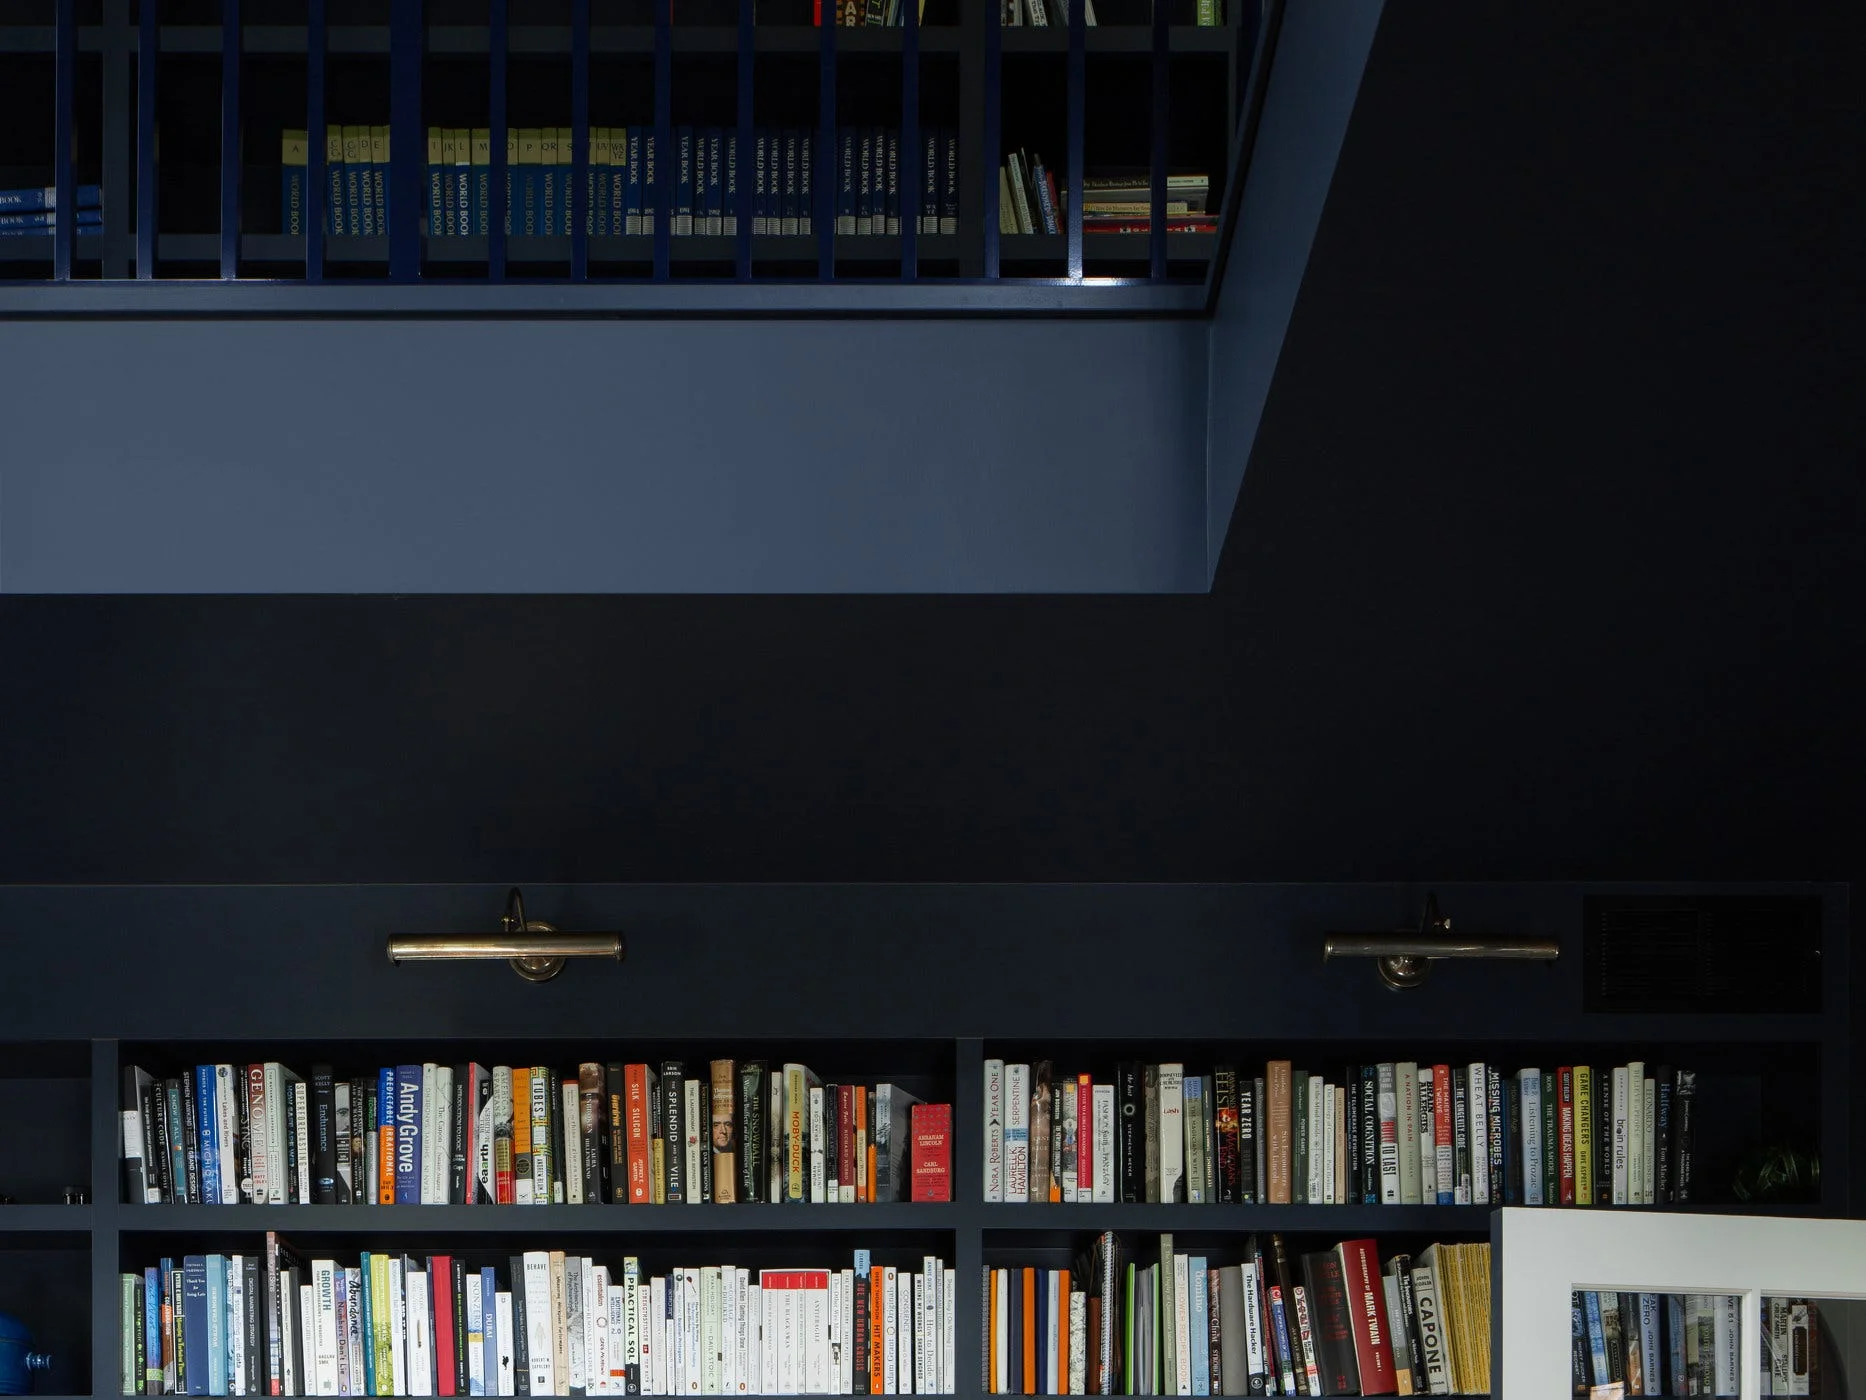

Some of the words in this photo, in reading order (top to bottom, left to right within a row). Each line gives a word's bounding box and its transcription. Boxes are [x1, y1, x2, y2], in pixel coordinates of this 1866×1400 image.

[630, 137, 638, 159] YEAR
[681, 136, 689, 157] YEAR
[332, 170, 341, 204] WORLD
[630, 161, 638, 184] BOOK
[681, 160, 689, 184] BOOK
[334, 207, 342, 235] BOOK
[534, 1082, 544, 1112] TUBES
[990, 1073, 998, 1092] ONE
[1364, 1081, 1373, 1114] SOCIAL
[1475, 1067, 1483, 1107] WHEAT
[1491, 1072, 1500, 1112] MISSING
[1580, 1073, 1588, 1096] GAME
[251, 1069, 264, 1147] GENOME
[397, 1082, 419, 1125] Andy
[669, 1092, 677, 1142] SPLENDID
[990, 1094, 998, 1117] YEAR
[296, 1085, 306, 1166] SUPERFORECASTING
[320, 1104, 328, 1152] Endurance
[1381, 1121, 1394, 1143] BUILT
[1476, 1114, 1484, 1148] BELLY
[1581, 1100, 1590, 1145] CHANGERS
[399, 1126, 418, 1172] Grove
[792, 1112, 800, 1173] MOBY-DUCK
[989, 1130, 1000, 1164] ROBERTS
[1366, 1116, 1375, 1165] COGNITION
[1382, 1146, 1394, 1155] TO
[1492, 1116, 1502, 1165] MICROBES
[670, 1166, 679, 1187] VILE
[990, 1166, 999, 1192] NORA
[1383, 1157, 1396, 1176] LAST
[322, 1270, 331, 1311] GROWTH
[627, 1277, 635, 1337] PRACTICAL
[1364, 1292, 1375, 1317] MARK
[349, 1280, 361, 1336] Abundance
[1247, 1290, 1256, 1326] Hardware
[926, 1320, 934, 1336] How
[1367, 1318, 1380, 1345] TWAIN
[1420, 1297, 1441, 1374] CAPONE
[627, 1340, 636, 1360] SQL
[926, 1350, 934, 1376] Decide
